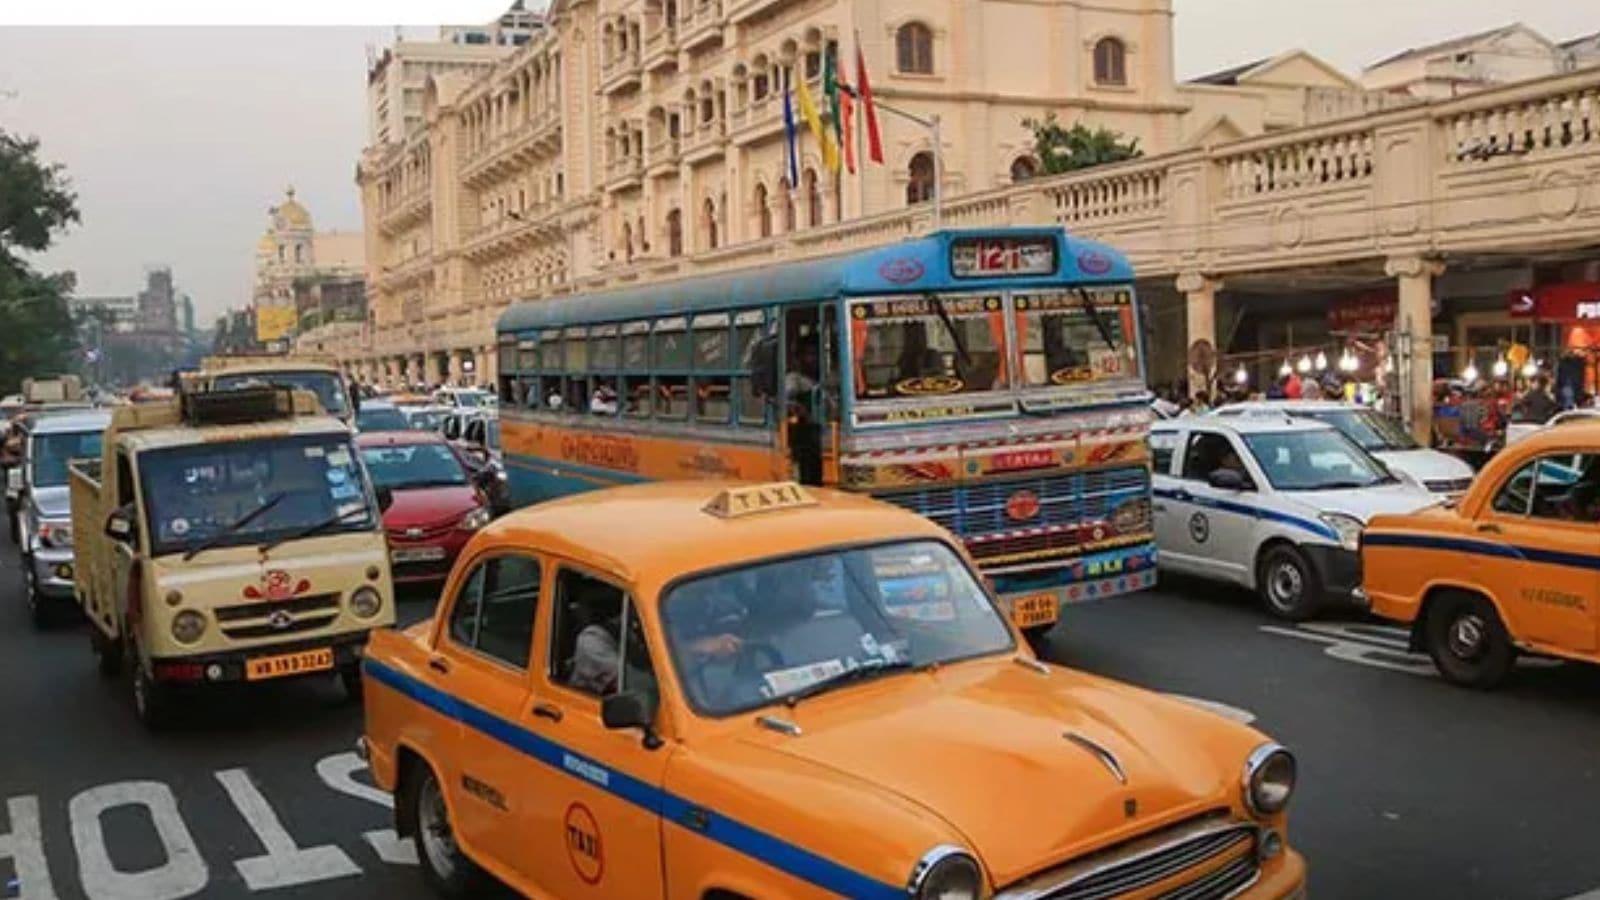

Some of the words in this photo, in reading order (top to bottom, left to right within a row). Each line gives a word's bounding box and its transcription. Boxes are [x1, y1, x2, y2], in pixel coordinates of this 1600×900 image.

[979, 237, 1019, 271] 121
[733, 485, 801, 509] TAXI
[568, 826, 598, 860] TAXI
